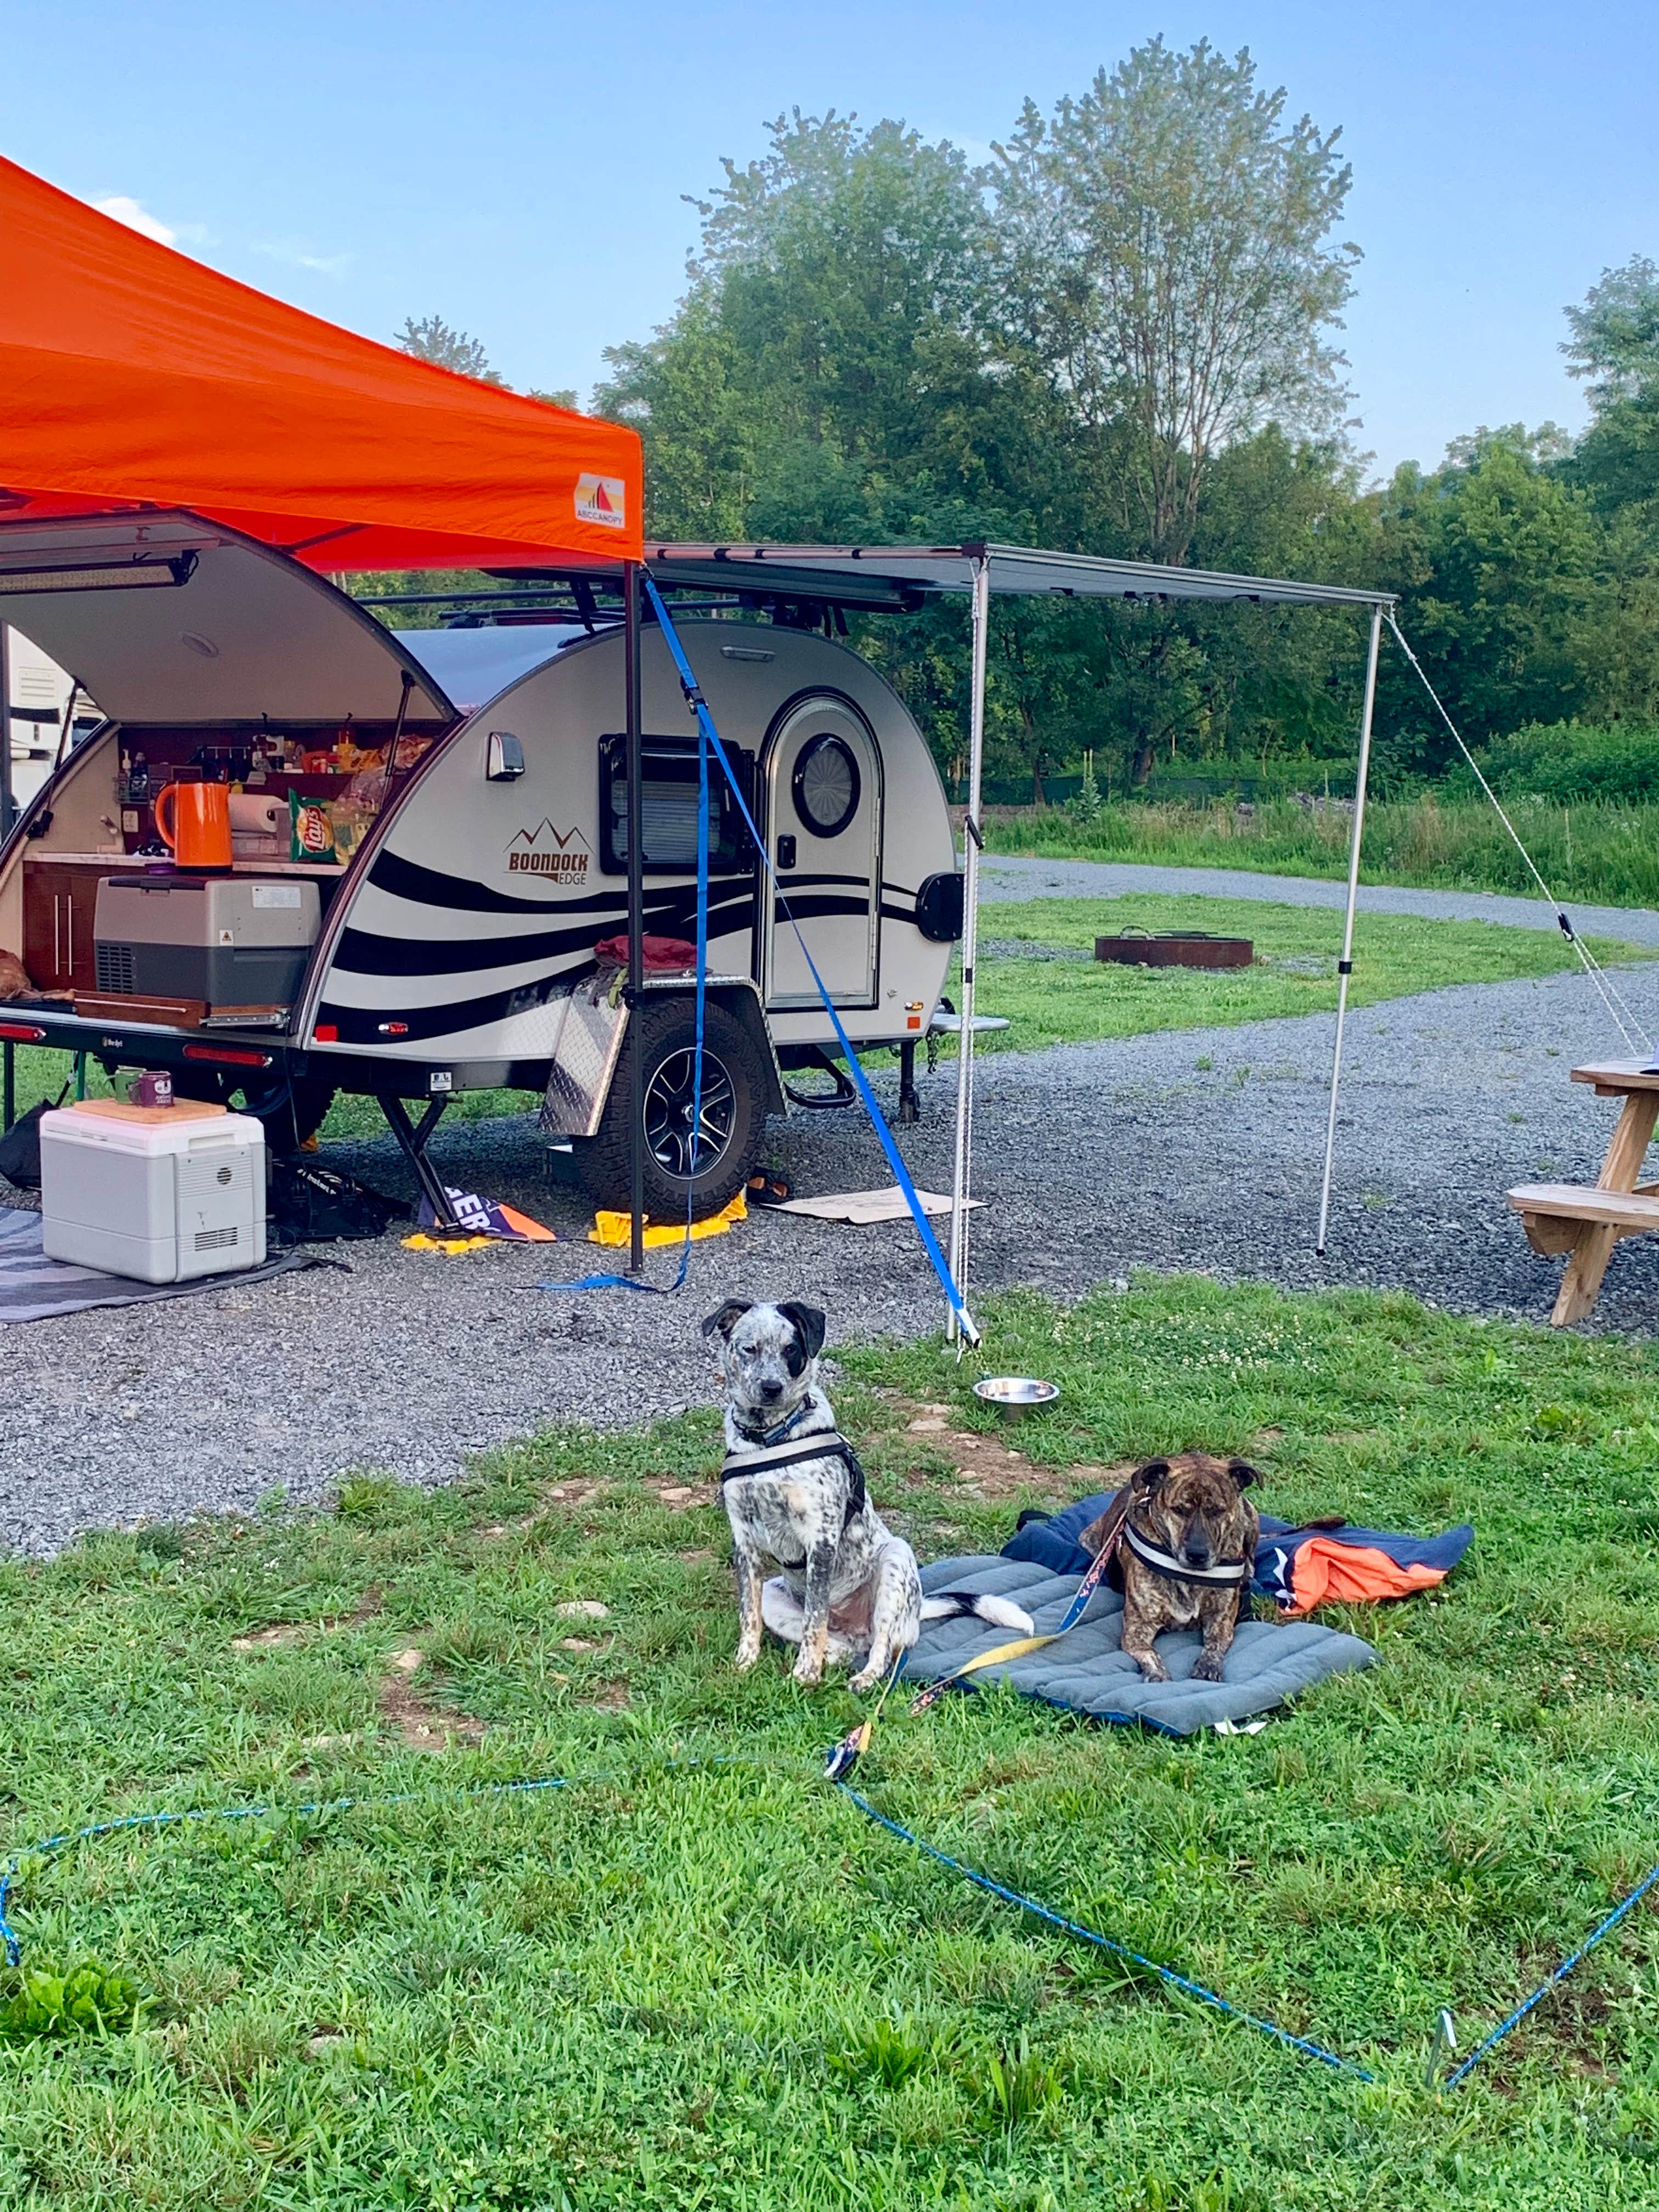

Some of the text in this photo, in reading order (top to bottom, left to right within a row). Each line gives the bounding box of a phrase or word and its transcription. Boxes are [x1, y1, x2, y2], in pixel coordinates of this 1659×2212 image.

[578, 510, 622, 524] ABCCANOPY
[509, 853, 589, 871] BOONDOCK
[559, 873, 586, 885] EDGE
